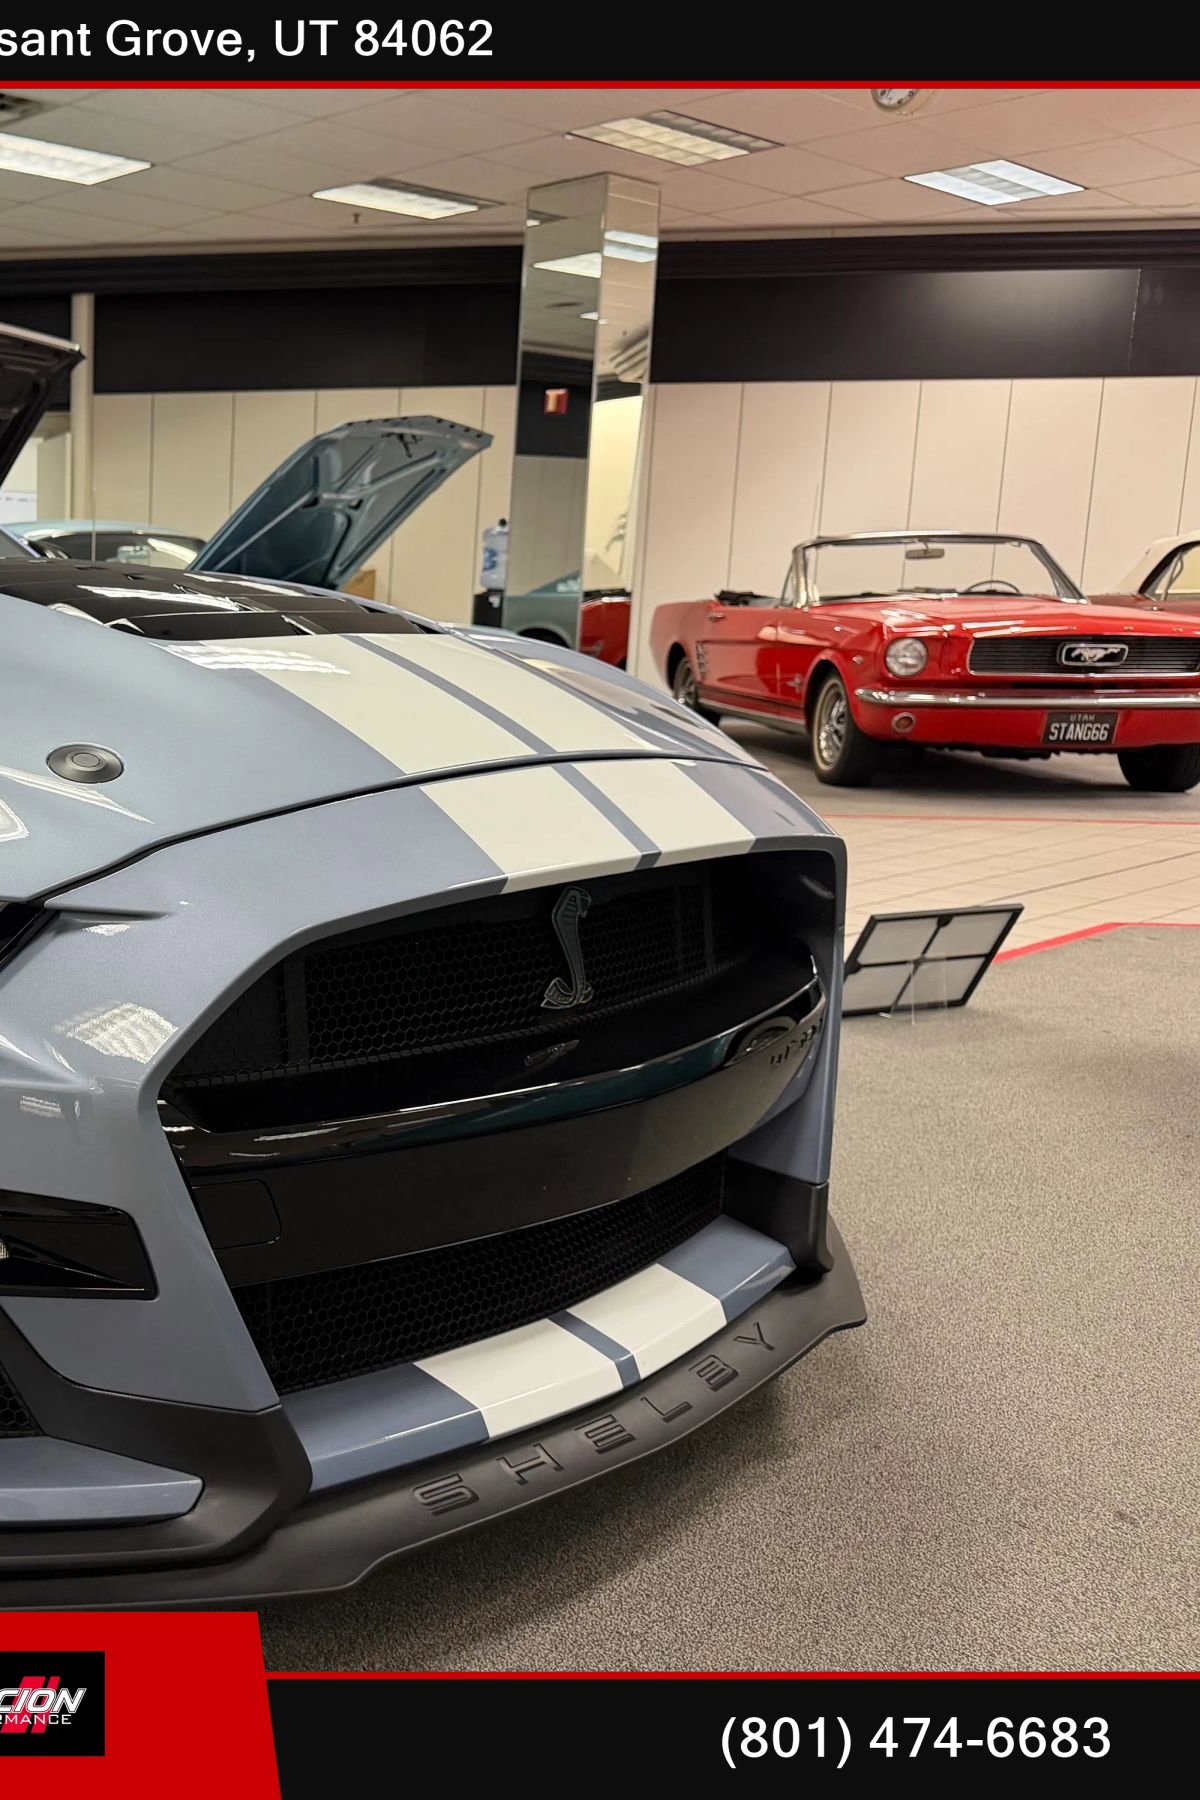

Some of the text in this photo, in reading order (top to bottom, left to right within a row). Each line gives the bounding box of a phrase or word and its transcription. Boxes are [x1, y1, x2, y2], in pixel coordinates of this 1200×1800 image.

[1070, 714, 1095, 722] UTAH
[1048, 723, 1110, 741] STANG66
[412, 1322, 776, 1516] SHELBY
